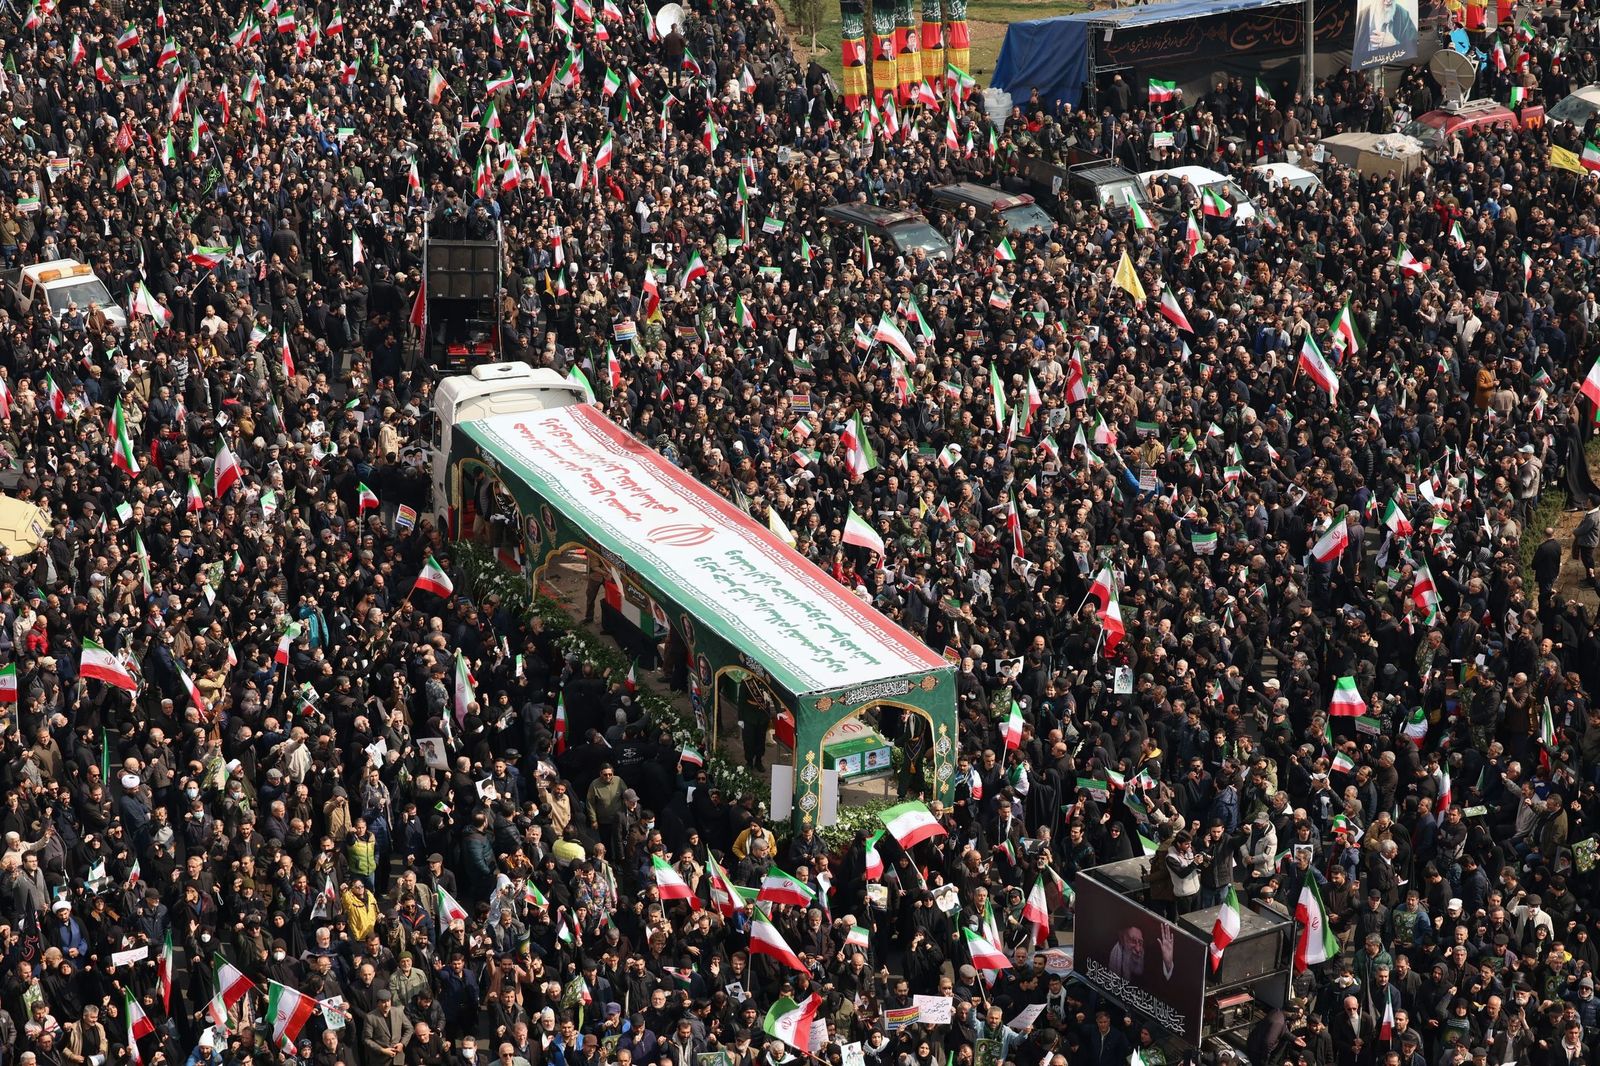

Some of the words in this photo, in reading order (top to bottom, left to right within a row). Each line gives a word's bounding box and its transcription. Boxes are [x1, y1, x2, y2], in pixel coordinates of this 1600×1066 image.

[1361, 56, 1375, 66] است
[1388, 49, 1406, 62] خدای
[545, 424, 573, 439] برای
[513, 423, 536, 439] همه
[582, 473, 617, 498] متعال
[612, 475, 651, 492] نظام
[630, 491, 679, 514] اسلامی
[696, 562, 727, 573] زیر
[713, 572, 747, 588] چتر
[721, 588, 767, 604] قرآن
[729, 555, 757, 572] ملت
[743, 571, 783, 587] ایران
[771, 587, 801, 605] حتما
[792, 599, 832, 622] پیروز
[813, 622, 862, 652] خواهد
[849, 651, 882, 665] شد
[753, 607, 800, 628] اسلام
[777, 629, 833, 657] تضمین
[810, 657, 849, 673] کرده
